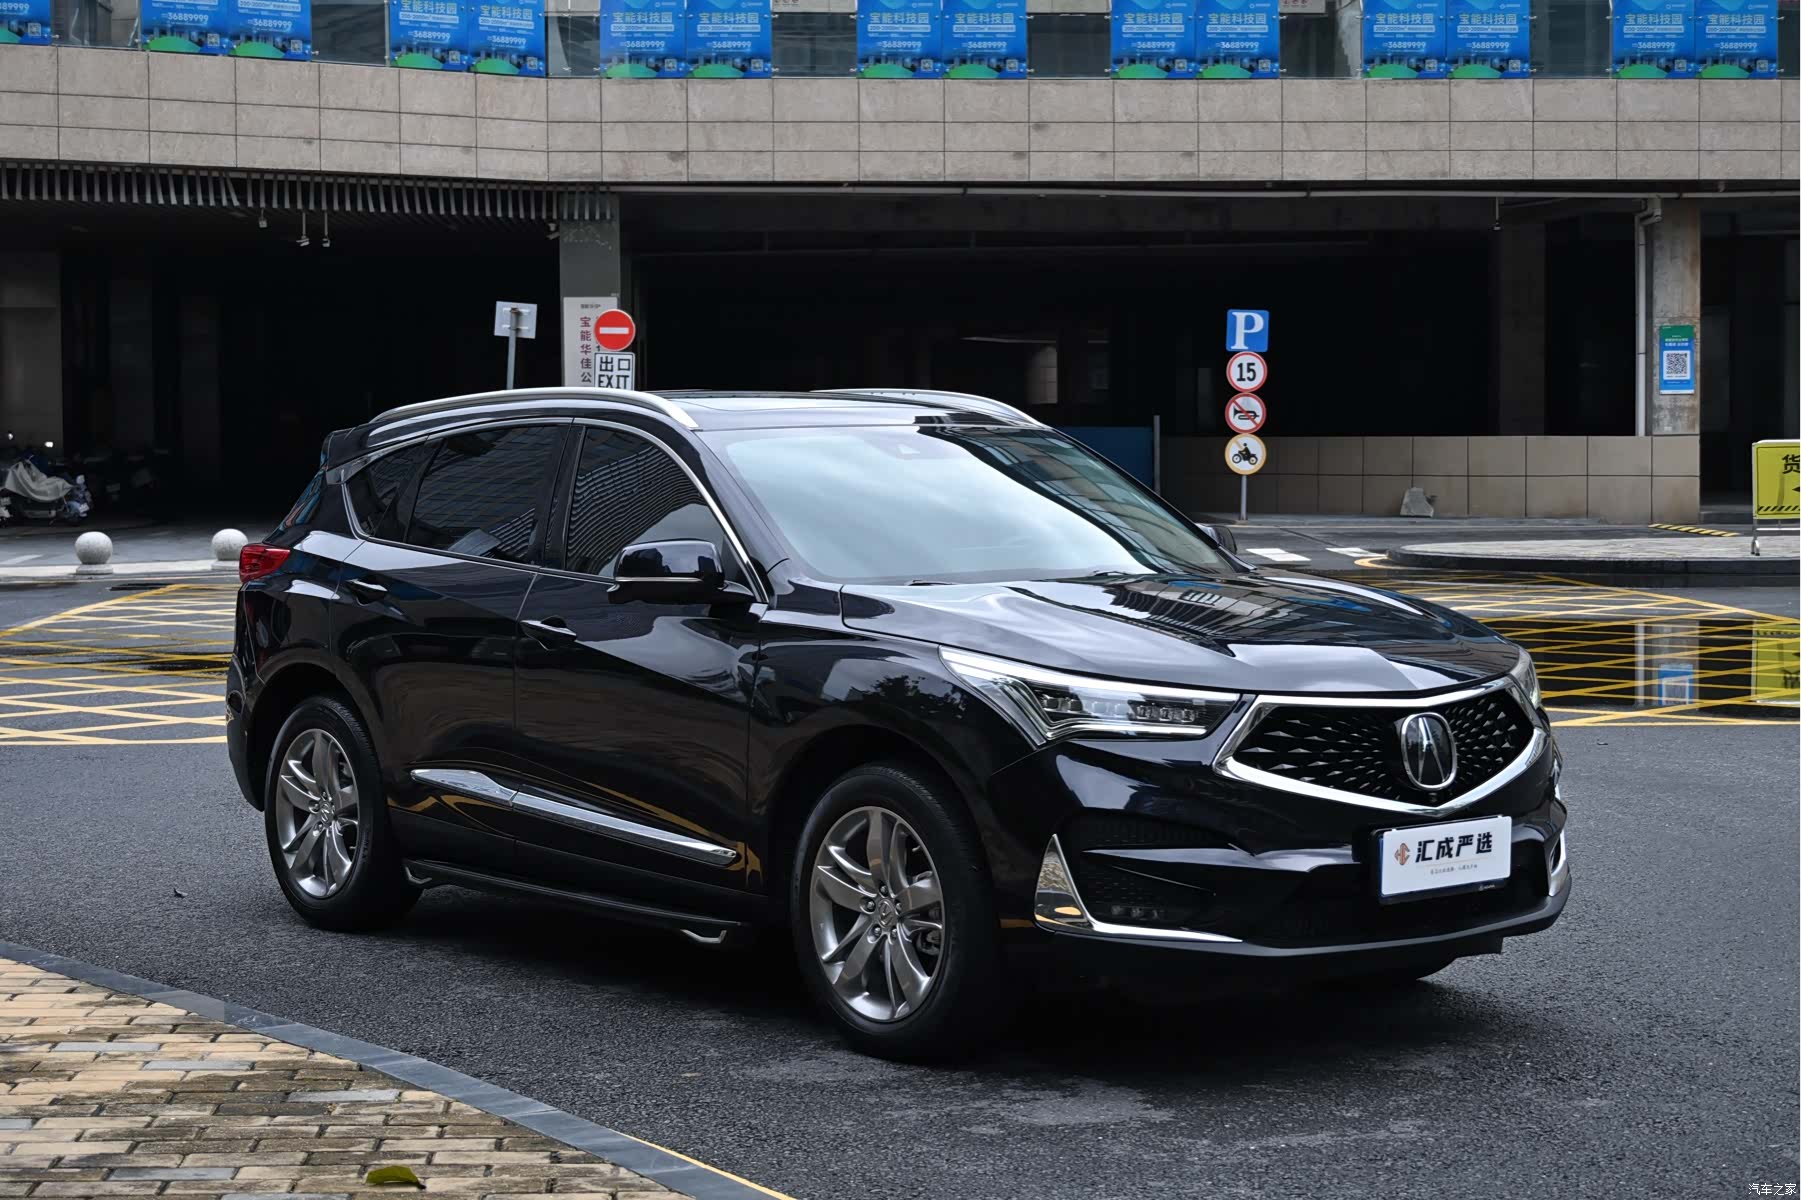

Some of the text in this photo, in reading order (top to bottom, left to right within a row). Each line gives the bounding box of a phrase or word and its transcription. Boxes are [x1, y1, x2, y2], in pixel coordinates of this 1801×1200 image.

[401, 0, 457, 14] 宝能科技园
[480, 5, 533, 20] 宝能科技园
[168, 12, 208, 21] 36889999
[612, 12, 672, 23] 宝能科技园
[699, 12, 759, 24] 宝能科技园
[870, 12, 929, 24] 宝能科技园
[955, 13, 1014, 24] 宝能科技园
[1124, 13, 1183, 24] 宝能科技园
[1208, 13, 1267, 24] 宝能科技园
[1376, 13, 1434, 24] 宝能科技园
[1459, 13, 1516, 25] 宝能科技园
[1625, 14, 1683, 25] 宝能科技园
[1708, 14, 1764, 25] 宝能科技园
[254, 19, 292, 28] 36889999
[414, 30, 450, 40] 36889999
[492, 35, 526, 44] 36889999
[967, 41, 1007, 49] 36889999
[1231, 312, 1264, 350] P
[600, 356, 630, 372] 出口
[1236, 362, 1256, 382] 15
[598, 374, 629, 389] EXIT
[1415, 832, 1492, 862] 汇成严选
